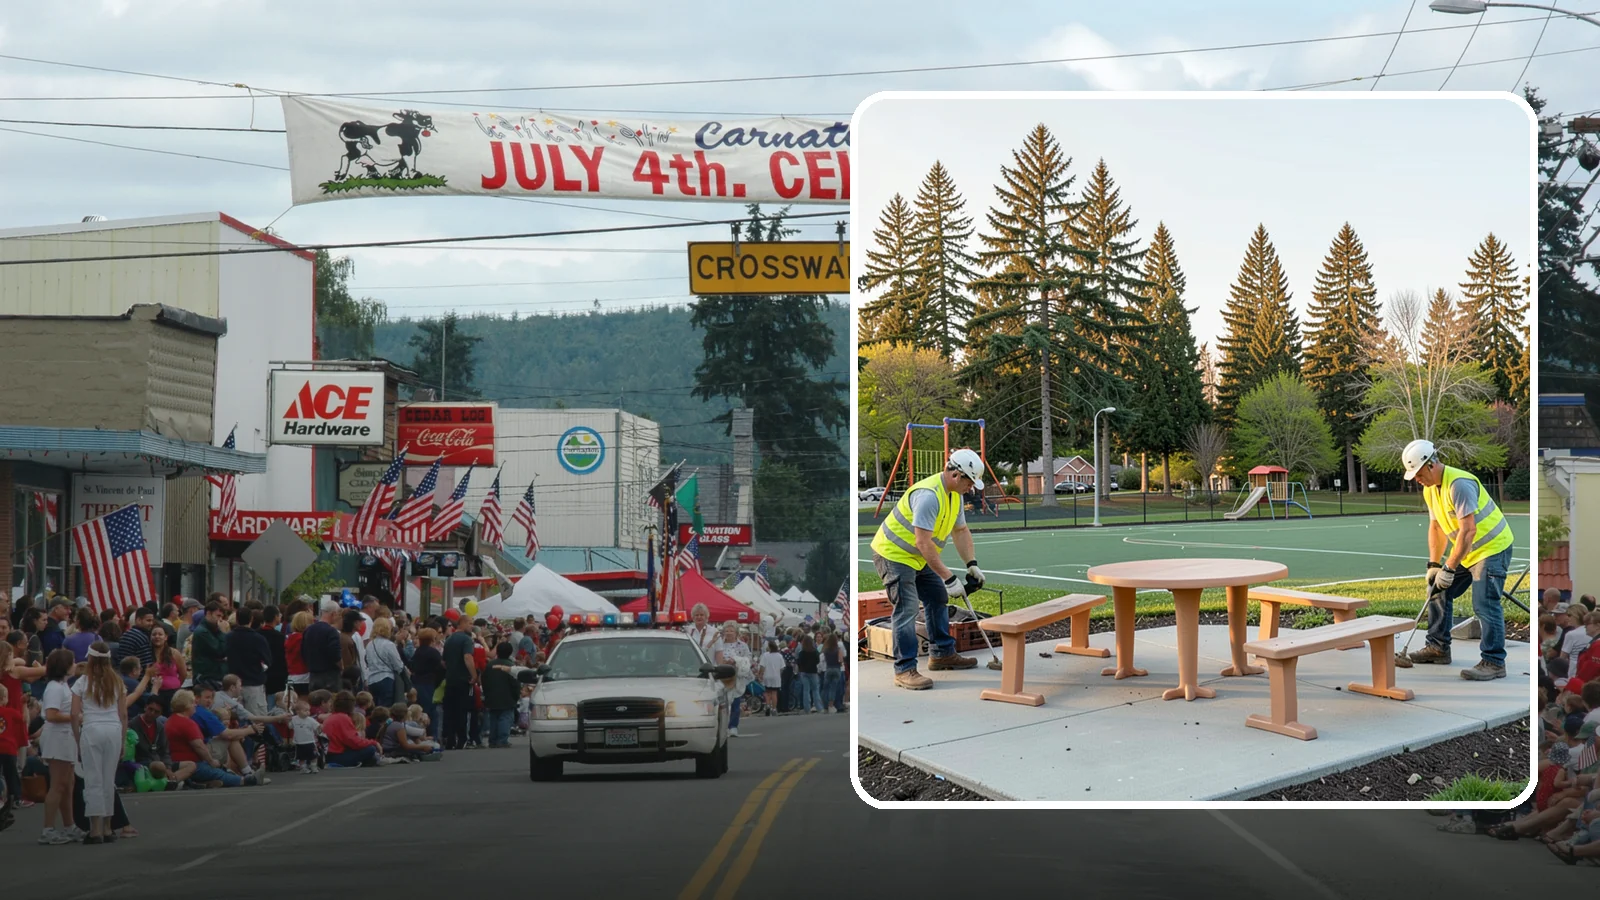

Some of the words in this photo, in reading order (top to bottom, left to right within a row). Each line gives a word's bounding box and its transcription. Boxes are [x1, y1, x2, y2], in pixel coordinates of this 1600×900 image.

[695, 121, 850, 150] Carnat
[481, 140, 605, 192] JULY
[632, 149, 746, 198] 4th.
[696, 253, 850, 281] CROSSWA
[282, 379, 374, 420] ACE
[405, 408, 453, 422] CEDAR
[283, 420, 371, 437] Hardware
[416, 428, 477, 447] Coca-Cola
[95, 485, 124, 495] Vincent
[126, 485, 136, 495] de
[137, 485, 155, 495] Paul
[688, 526, 742, 535] CRNATION
[699, 535, 731, 543] GLASS
